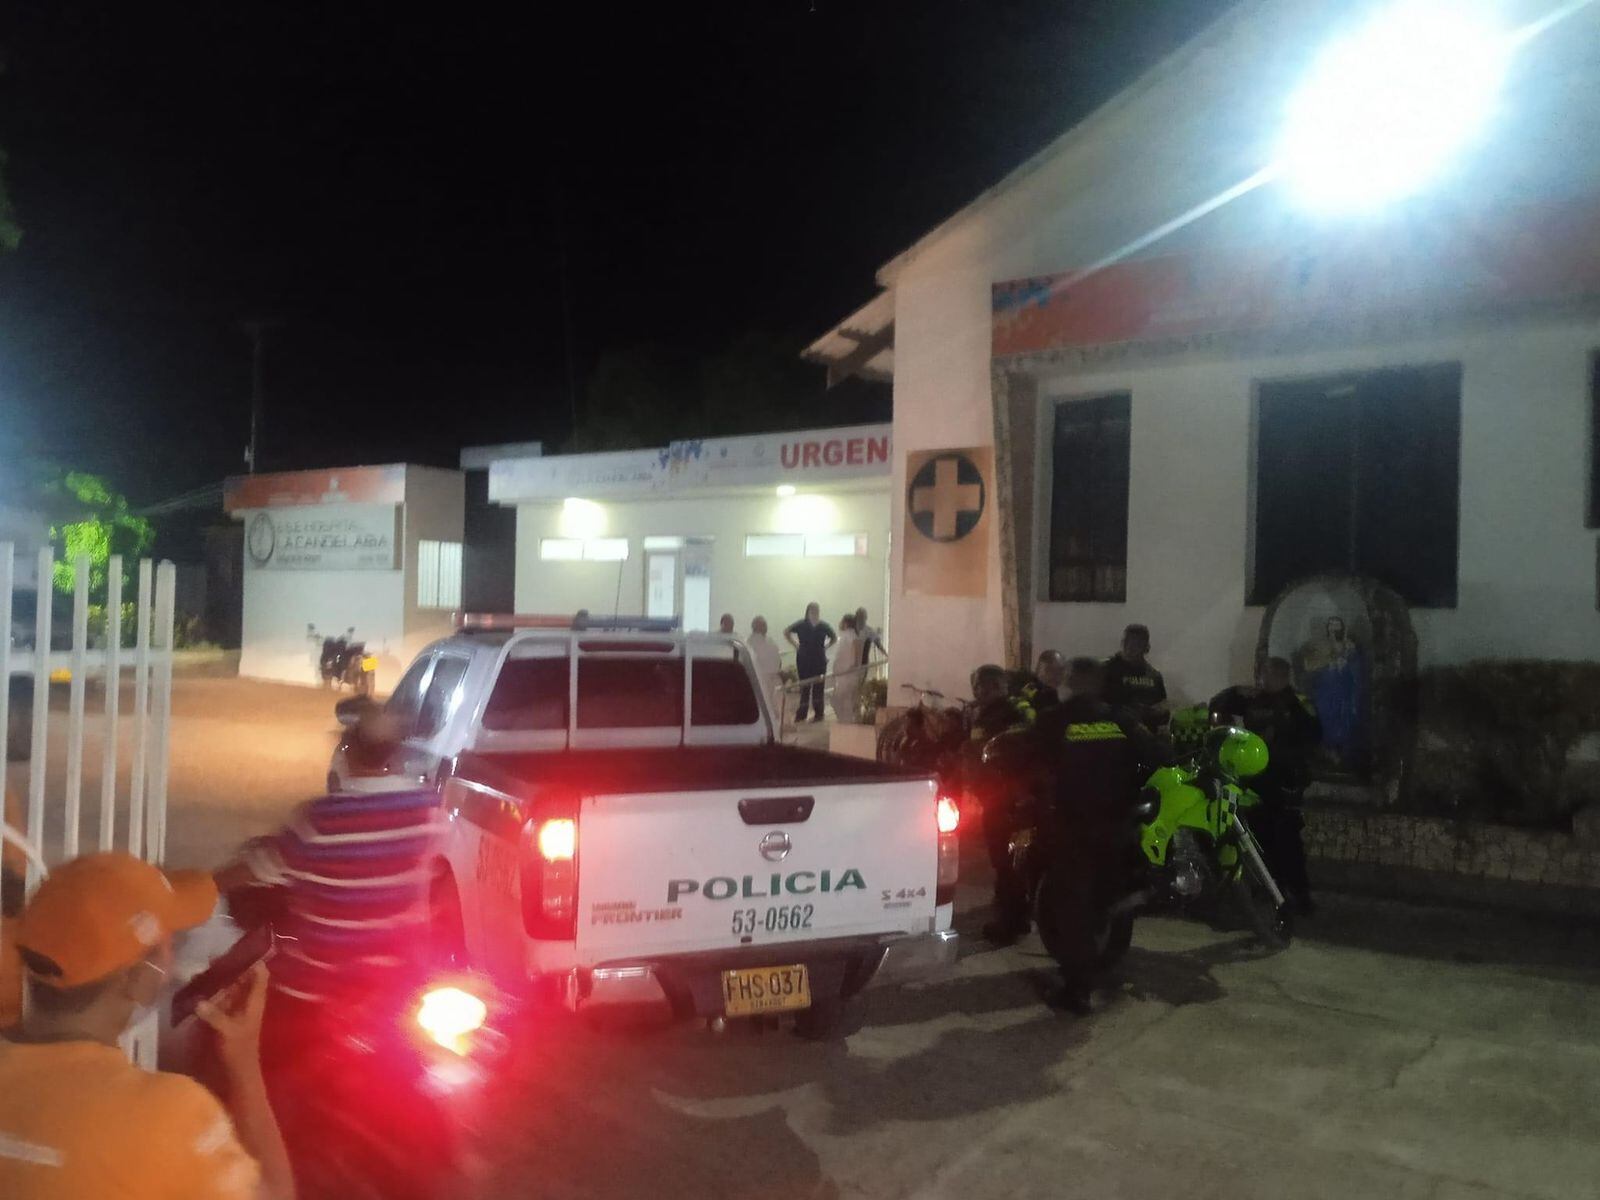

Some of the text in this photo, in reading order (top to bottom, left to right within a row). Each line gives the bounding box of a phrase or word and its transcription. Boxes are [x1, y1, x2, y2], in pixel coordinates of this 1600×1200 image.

[780, 436, 893, 469] URGEN
[667, 868, 867, 903] POLICIA
[732, 904, 814, 934] 53-0562
